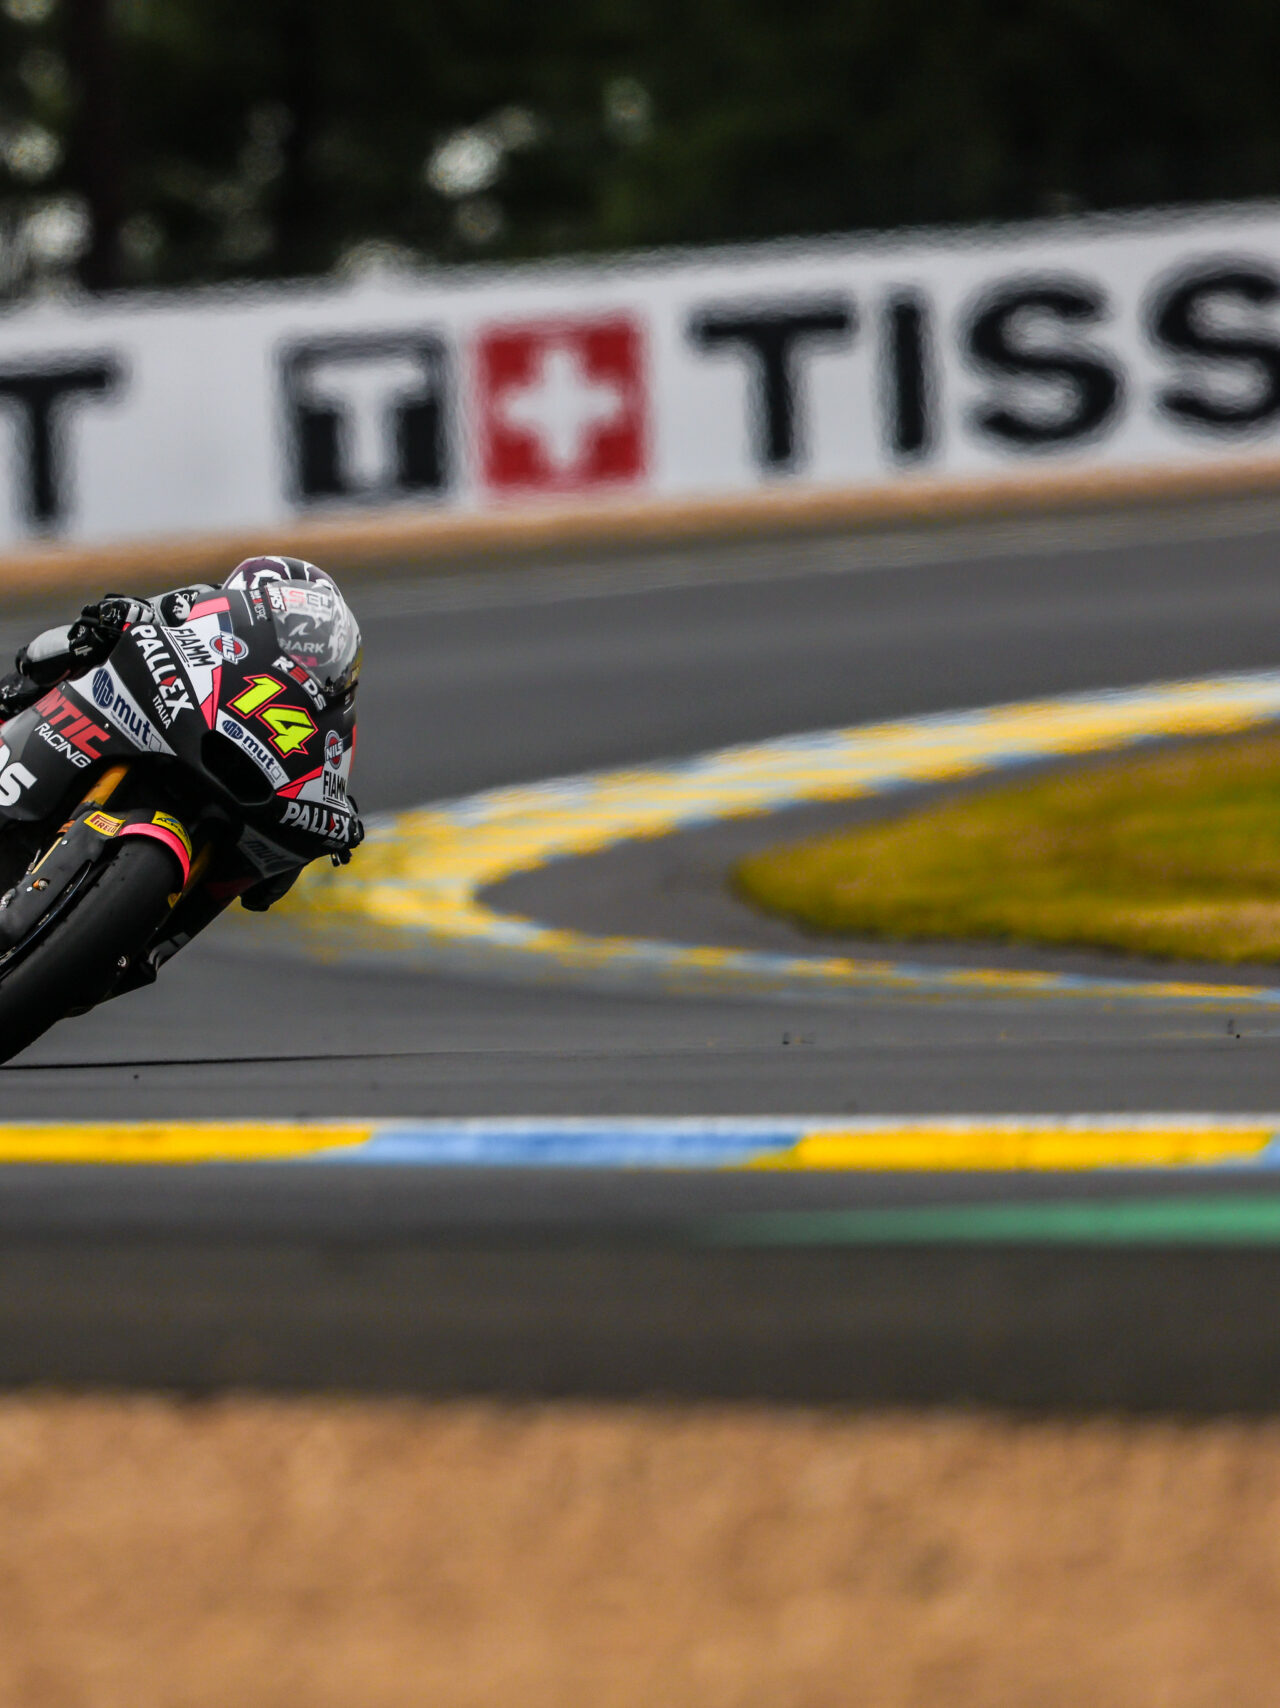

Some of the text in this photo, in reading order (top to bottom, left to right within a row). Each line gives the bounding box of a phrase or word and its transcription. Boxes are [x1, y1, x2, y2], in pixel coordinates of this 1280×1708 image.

[170, 628, 216, 667] FIAMM
[220, 632, 236, 664] NILS
[130, 624, 195, 722] PALLEX
[112, 694, 151, 745] mut
[152, 695, 173, 730] ITALIA
[226, 674, 319, 759] 14
[35, 722, 92, 768] RACING
[243, 736, 275, 770] mut
[326, 741, 343, 761] NILS
[280, 801, 350, 843] PALLEX
